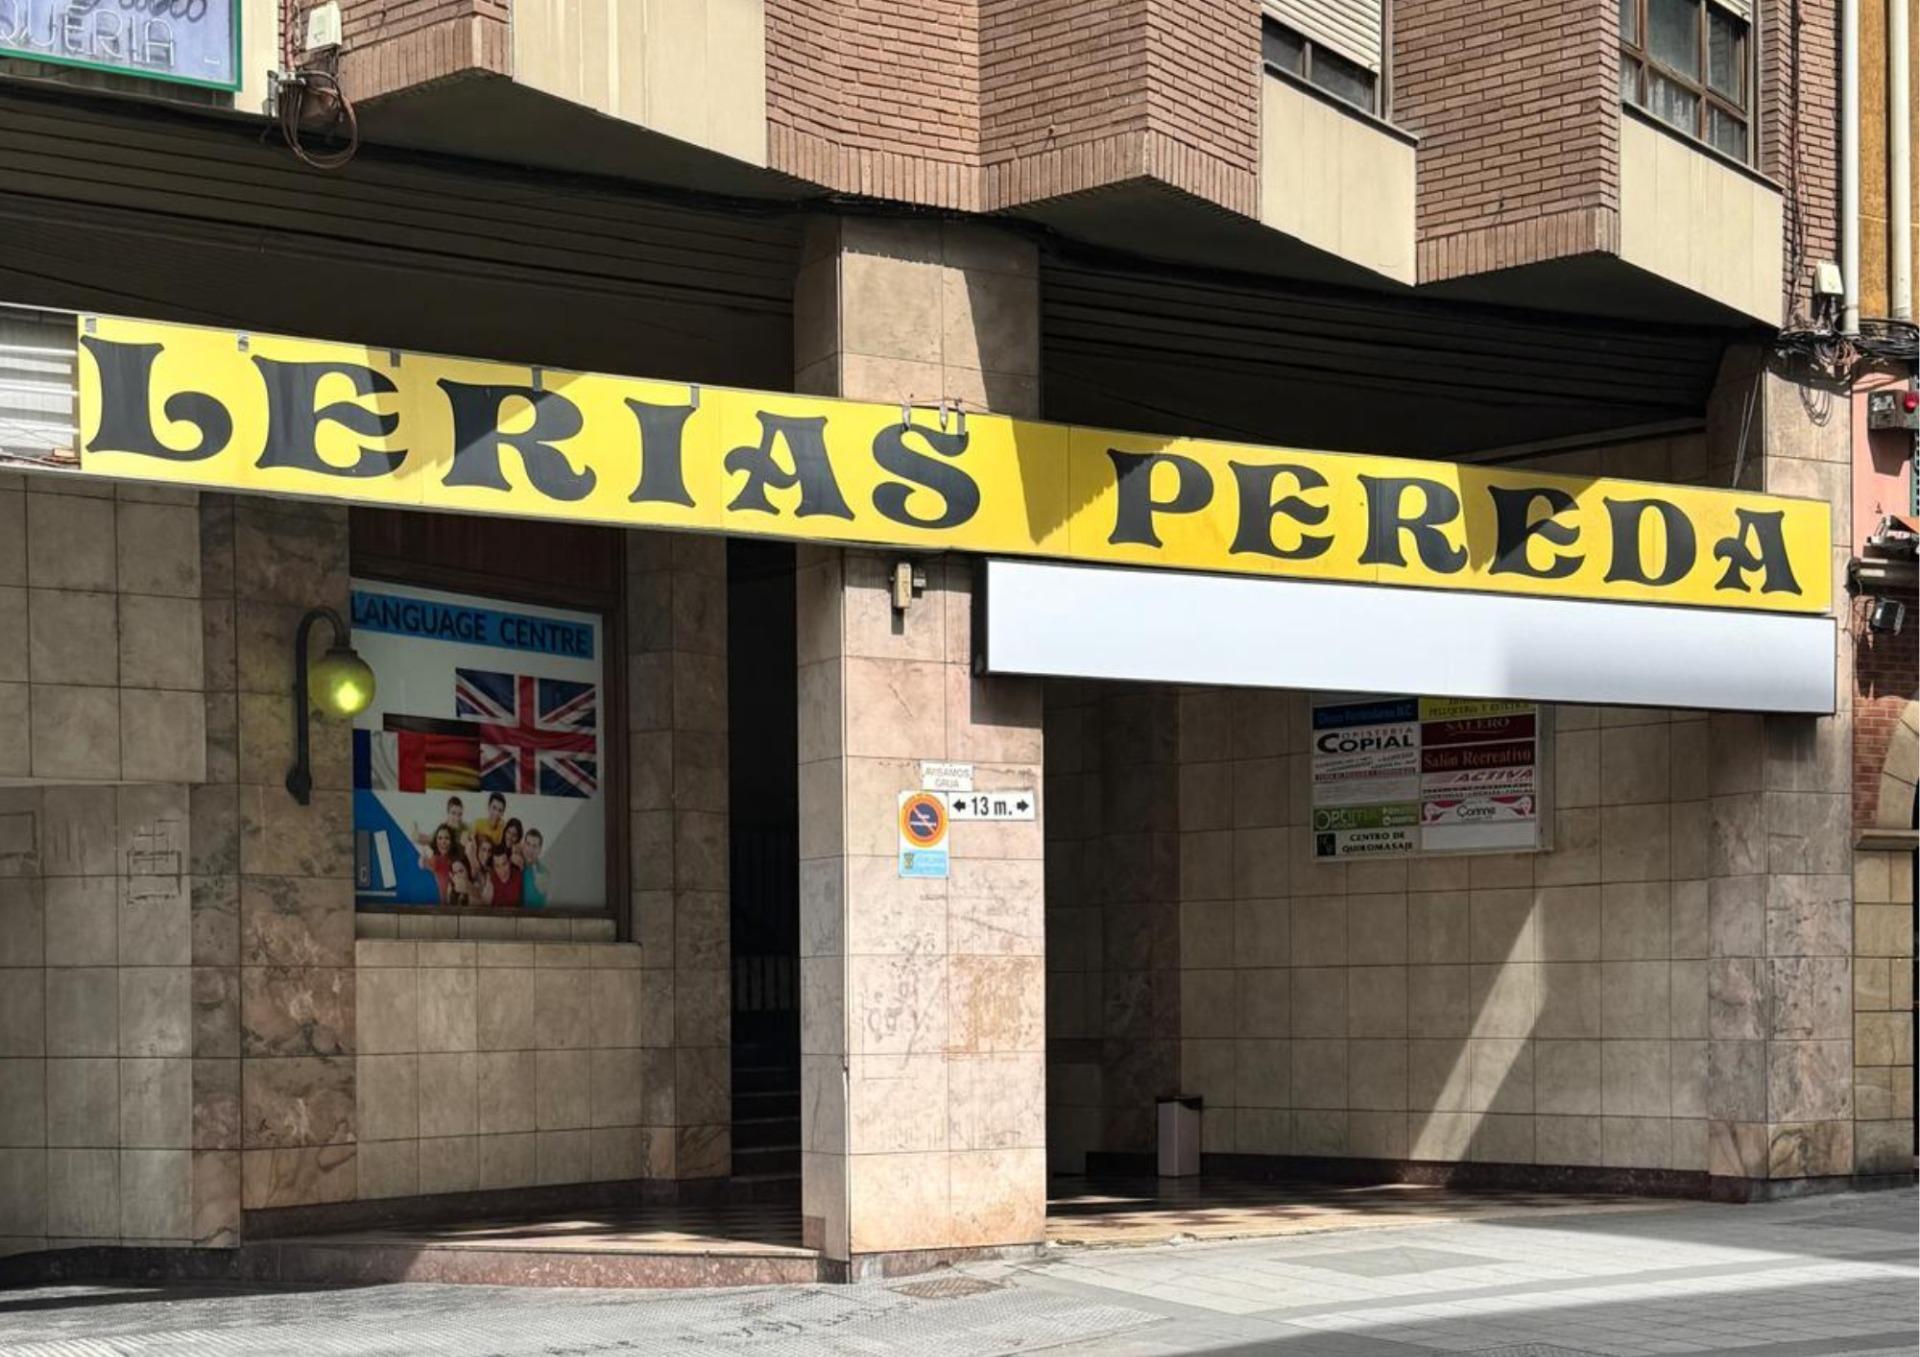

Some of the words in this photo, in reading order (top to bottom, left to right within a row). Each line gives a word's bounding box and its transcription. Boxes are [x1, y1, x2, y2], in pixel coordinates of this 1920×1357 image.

[80, 335, 981, 529] LERIAS
[1106, 447, 1803, 596] PEREDA
[351, 594, 487, 642] LANGUAGE
[500, 617, 590, 655] CENTRE
[1317, 733, 1415, 753] COPIAL
[1463, 746, 1532, 768] Recreativo
[1455, 769, 1533, 783] ACTIVA
[971, 796, 989, 816] 13
[993, 801, 1013, 816] m.
[1350, 831, 1390, 842] CENTRO
[1392, 830, 1405, 840] DE
[1342, 841, 1413, 853] QUIROMASAJE
